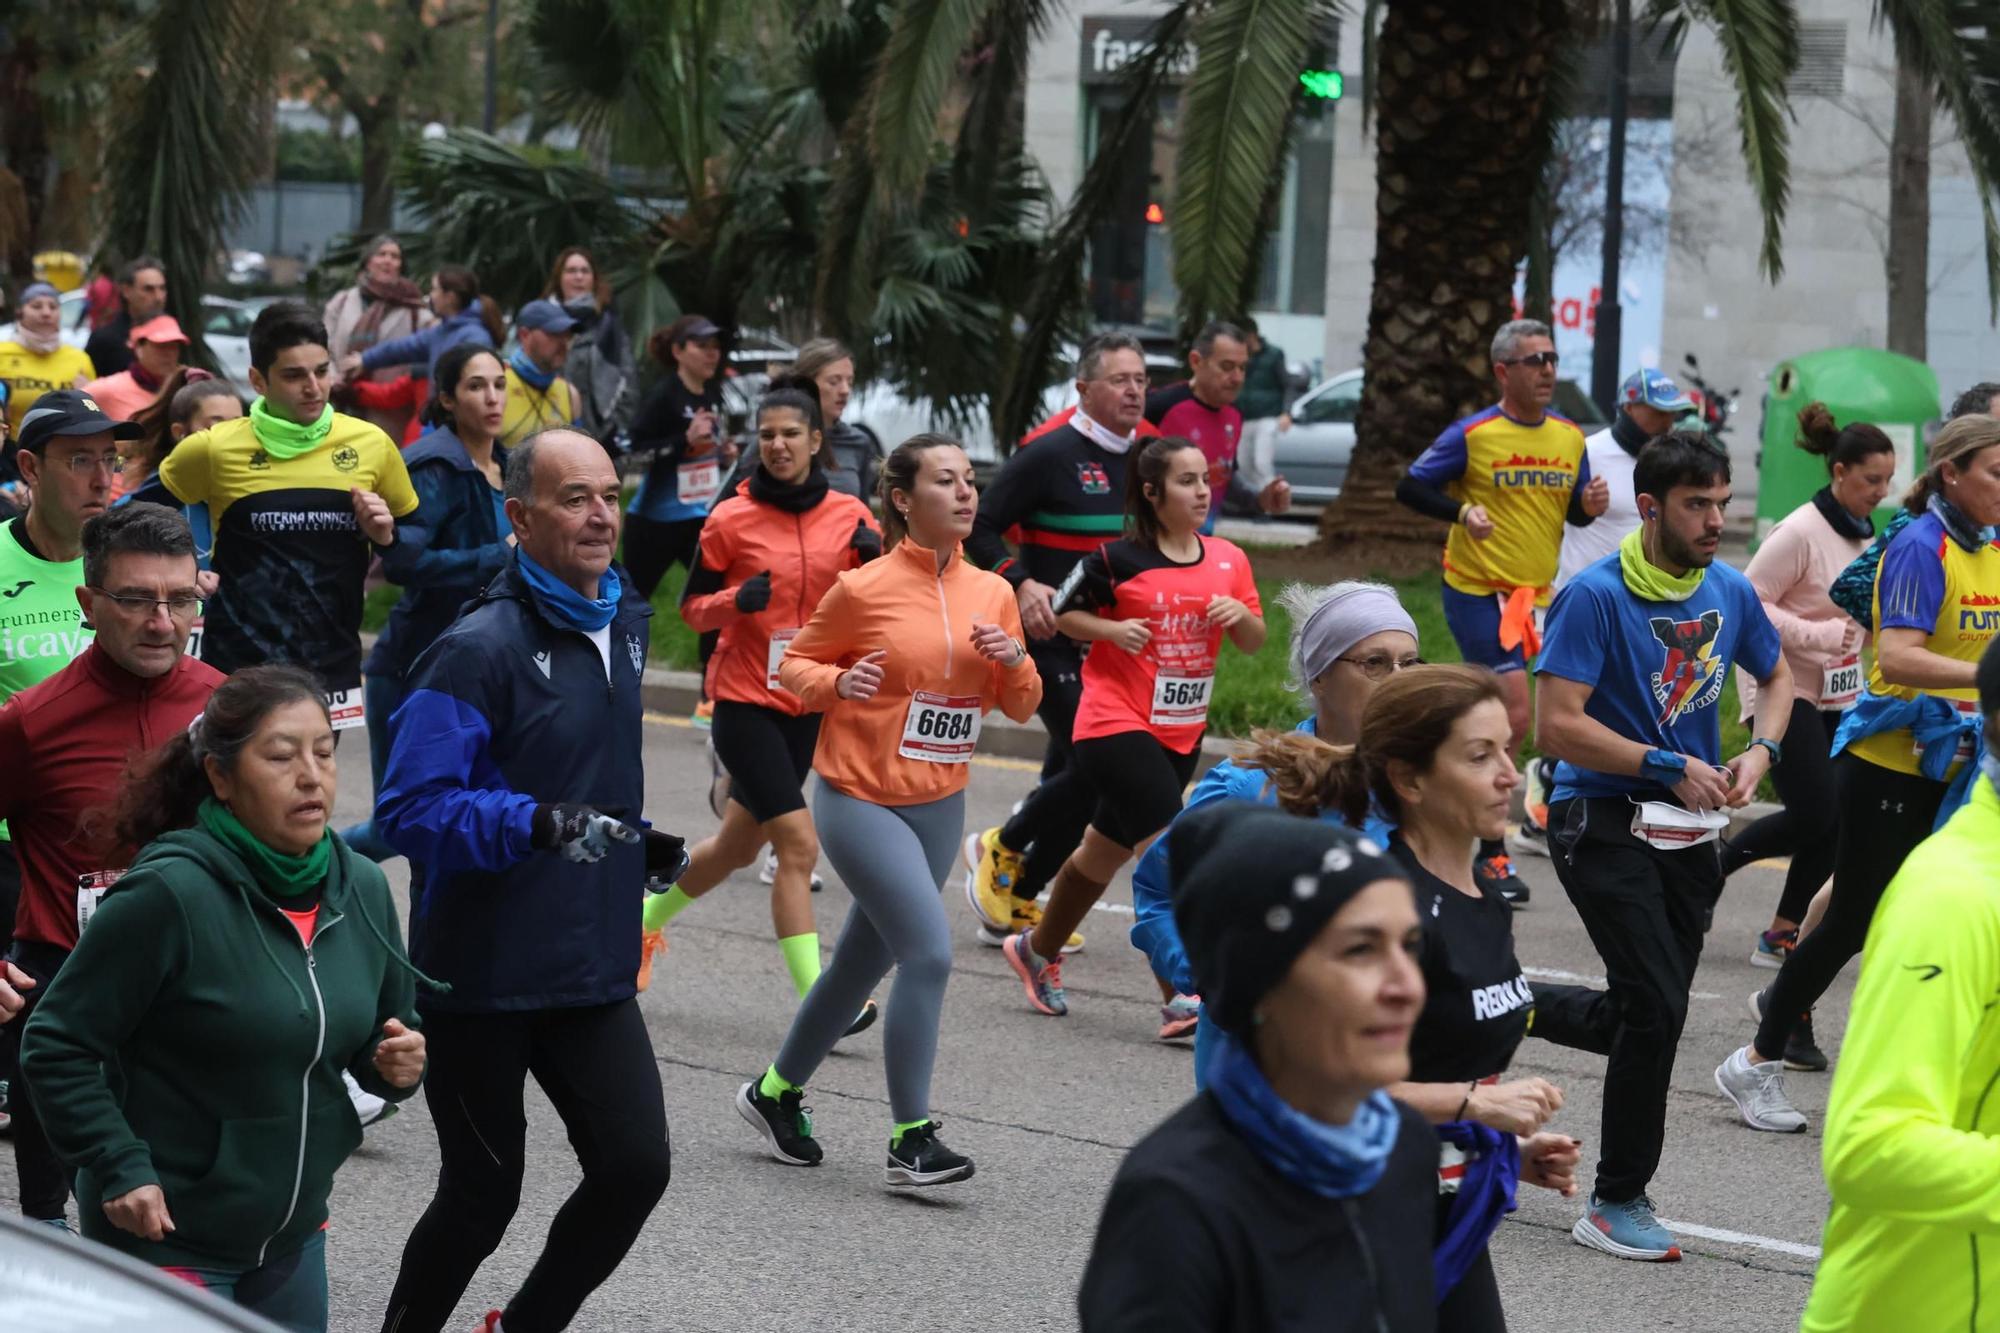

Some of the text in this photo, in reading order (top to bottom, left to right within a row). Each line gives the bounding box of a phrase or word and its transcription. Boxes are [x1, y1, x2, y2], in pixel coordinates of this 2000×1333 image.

[1494, 470, 1573, 488] runners
[251, 511, 305, 524] PATERNA
[1, 608, 80, 629] runners
[1831, 668, 1858, 693] 6822
[1163, 682, 1206, 704] 5634
[917, 709, 972, 739] 6684
